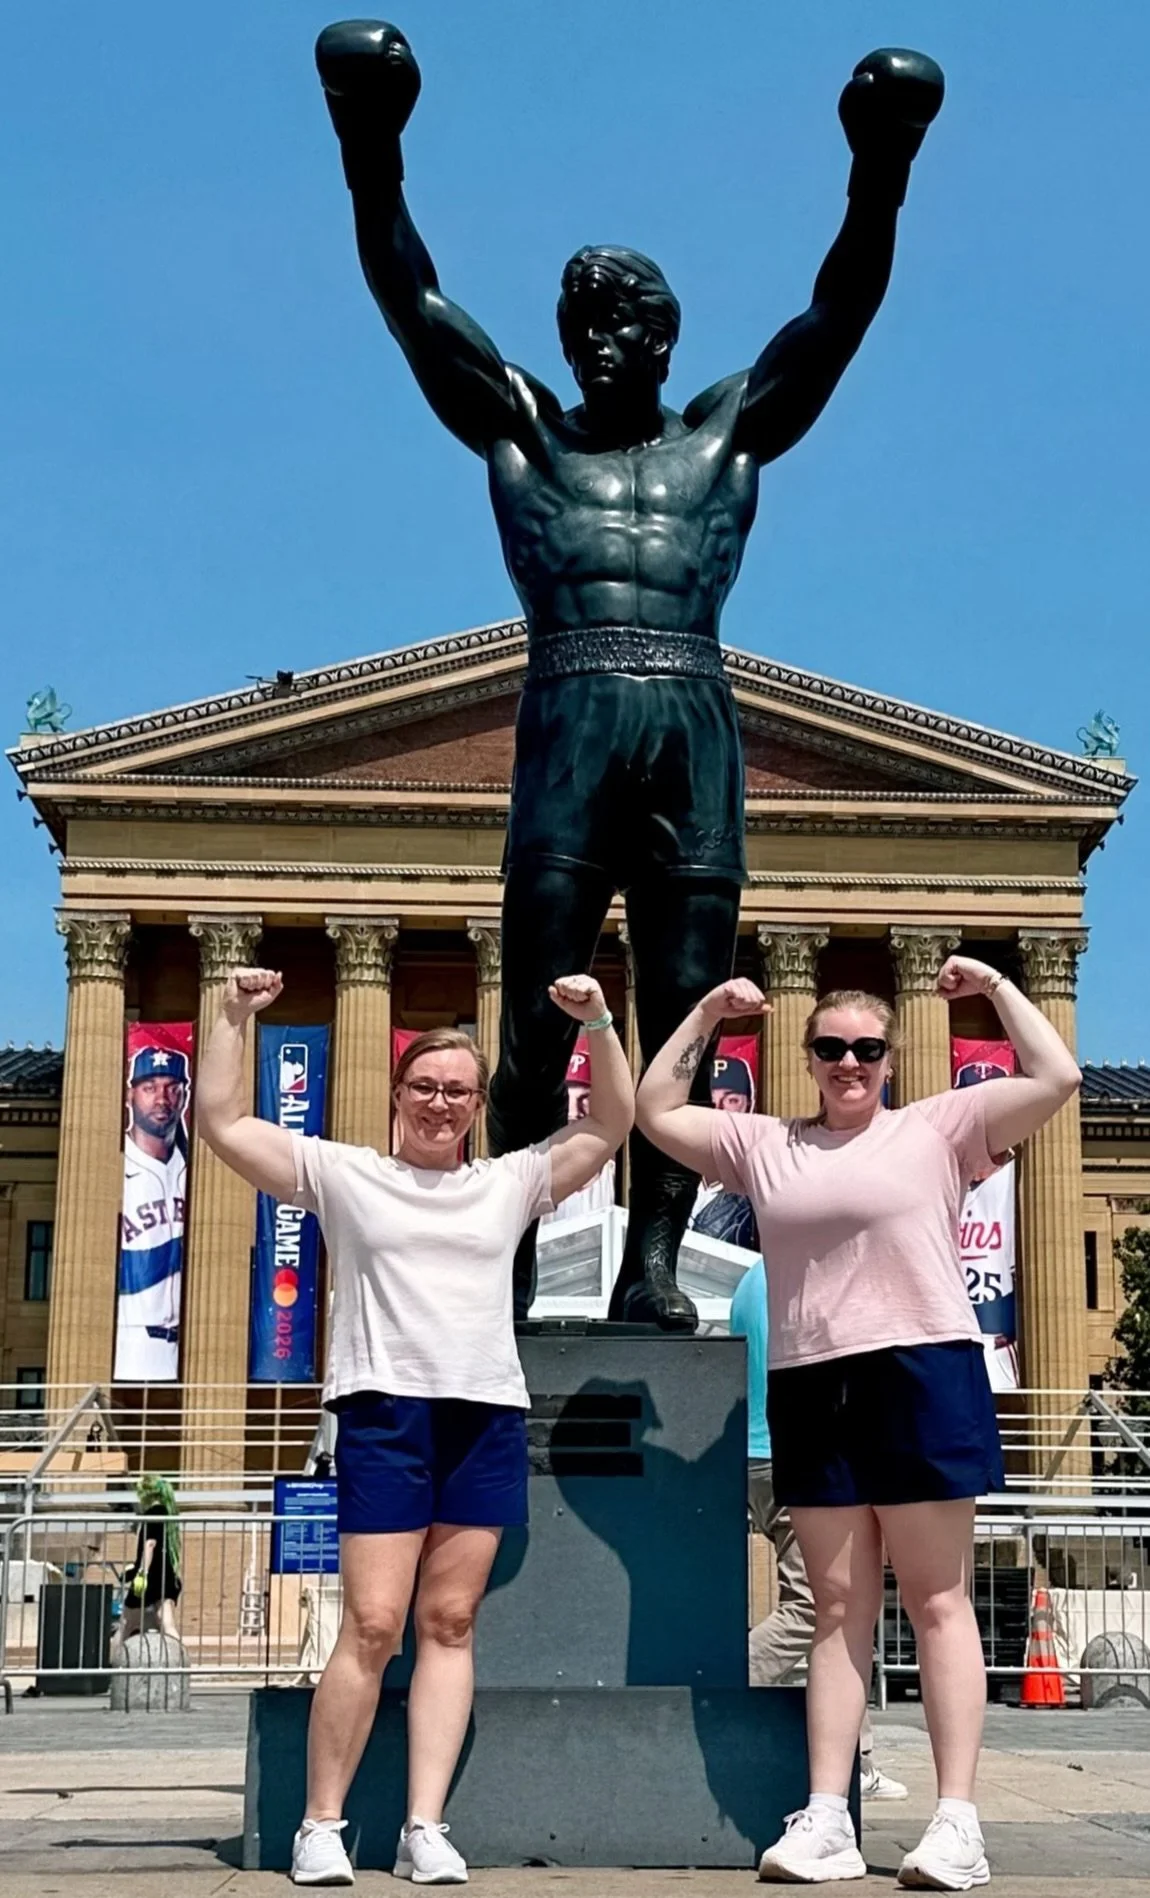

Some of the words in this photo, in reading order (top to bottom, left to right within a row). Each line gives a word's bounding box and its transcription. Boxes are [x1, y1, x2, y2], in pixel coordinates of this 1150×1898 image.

[714, 1060, 728, 1078] P
[274, 1203, 306, 1268] GAME
[273, 1311, 295, 1361] 2026
